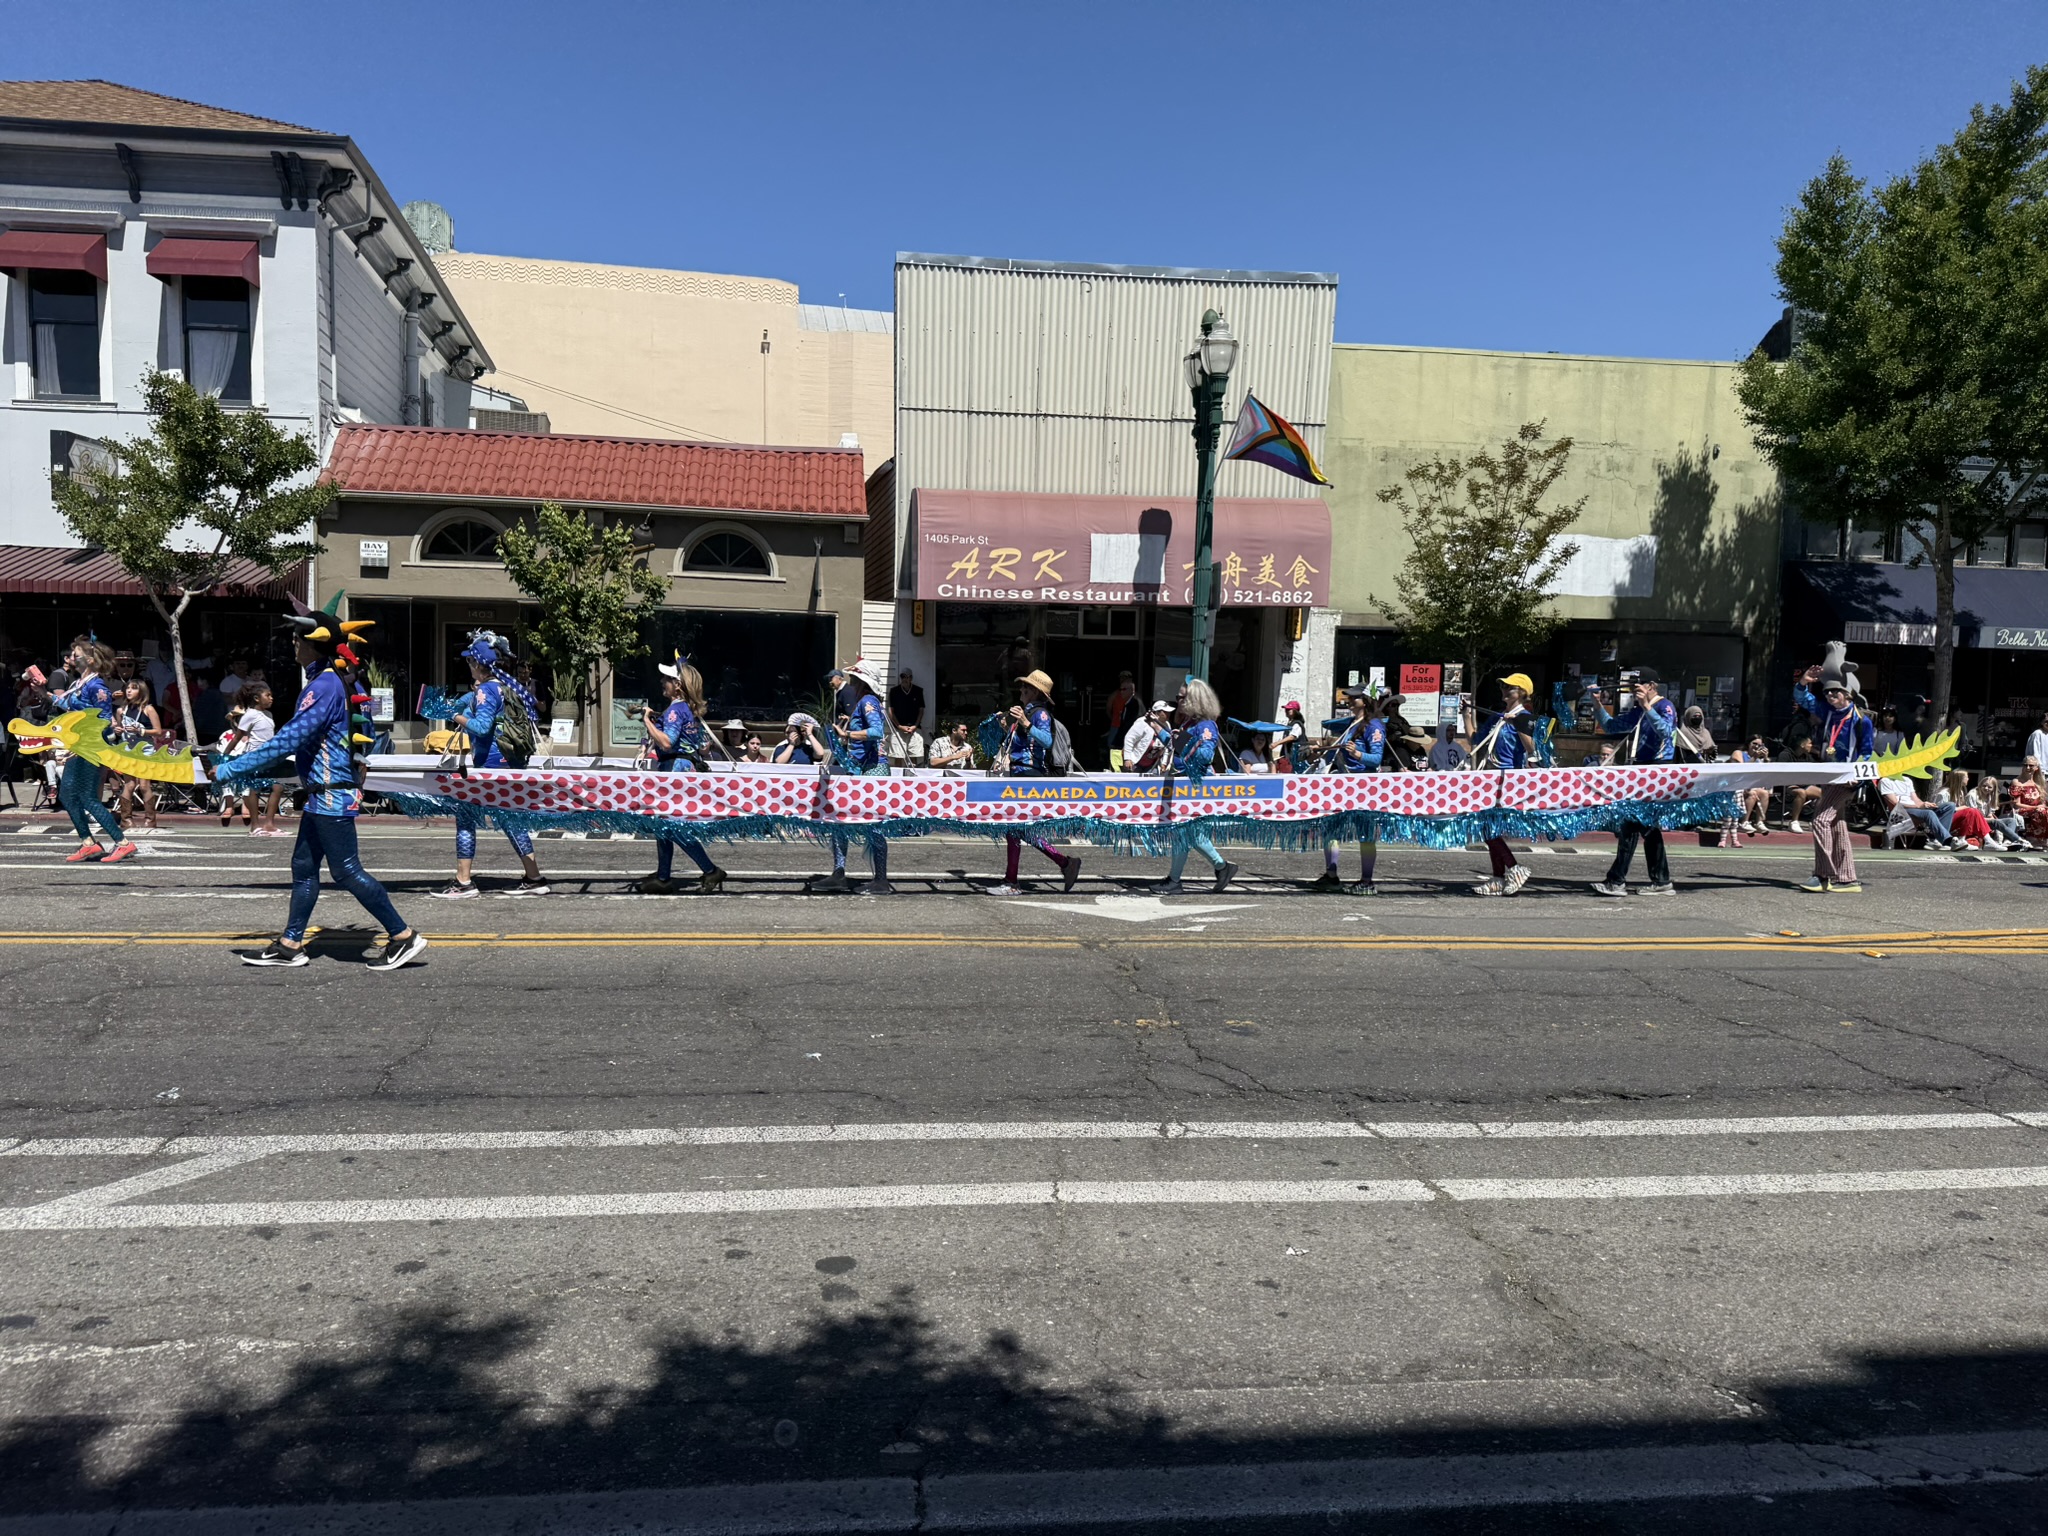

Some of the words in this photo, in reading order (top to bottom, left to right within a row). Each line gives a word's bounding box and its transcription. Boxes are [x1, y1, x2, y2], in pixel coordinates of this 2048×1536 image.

[924, 532, 950, 544] 1405
[951, 533, 976, 545] Park
[977, 534, 990, 546] St
[946, 546, 1068, 582] ARK
[937, 584, 1034, 600] Chinese
[1040, 586, 1170, 602] Restaurant
[1233, 589, 1313, 603] 521-6862
[1997, 628, 2028, 646] Bella
[1412, 666, 1429, 674] For
[1406, 675, 1434, 683] Lease
[2008, 697, 2029, 708] TK
[1854, 763, 1877, 778] 121
[1000, 785, 1098, 800] ALAMEDA
[1104, 784, 1257, 800] DRAGONFLYERS
